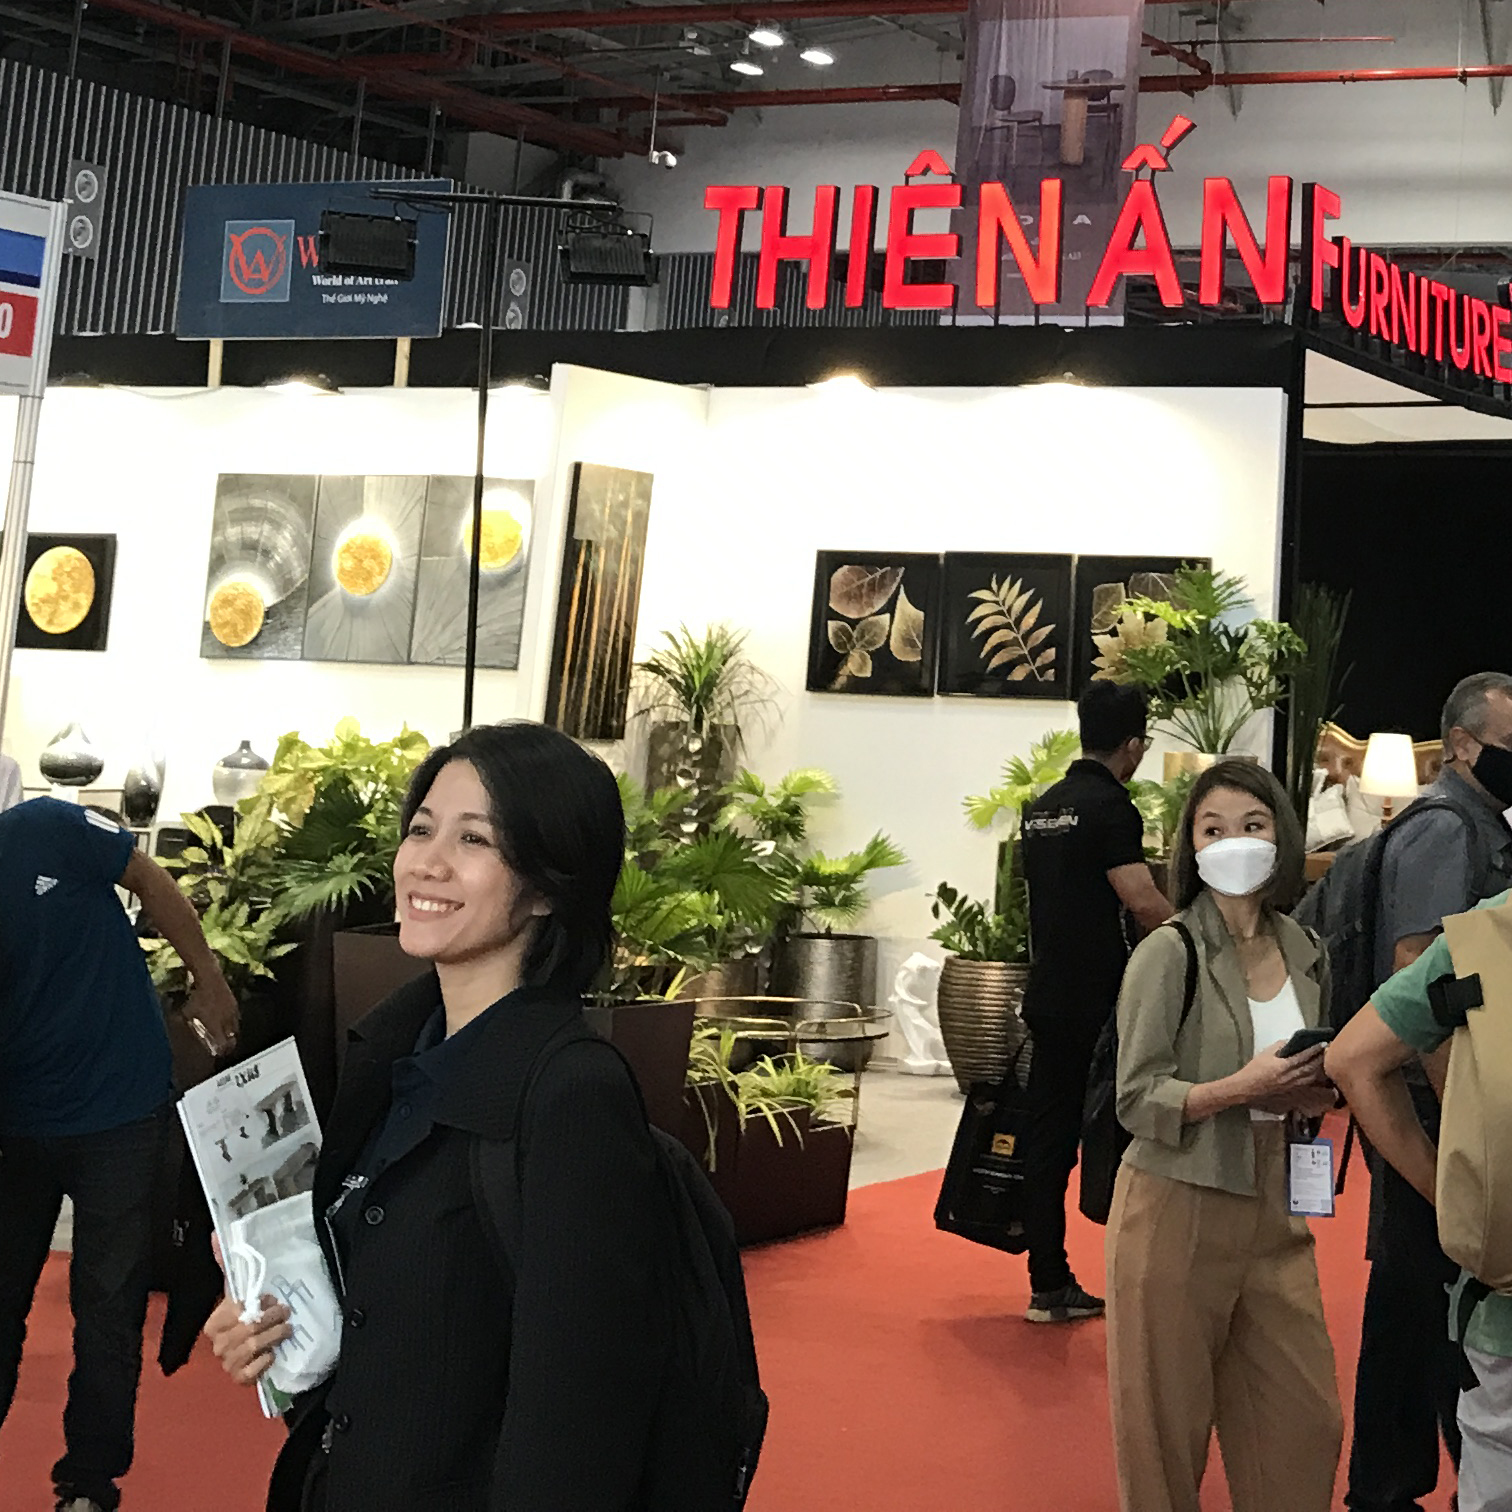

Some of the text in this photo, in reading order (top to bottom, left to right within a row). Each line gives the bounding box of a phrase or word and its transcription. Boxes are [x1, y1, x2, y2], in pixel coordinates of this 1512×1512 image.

[703, 114, 1293, 310] THIÊN ẤN
[312, 274, 343, 286] World
[344, 275, 355, 286] of
